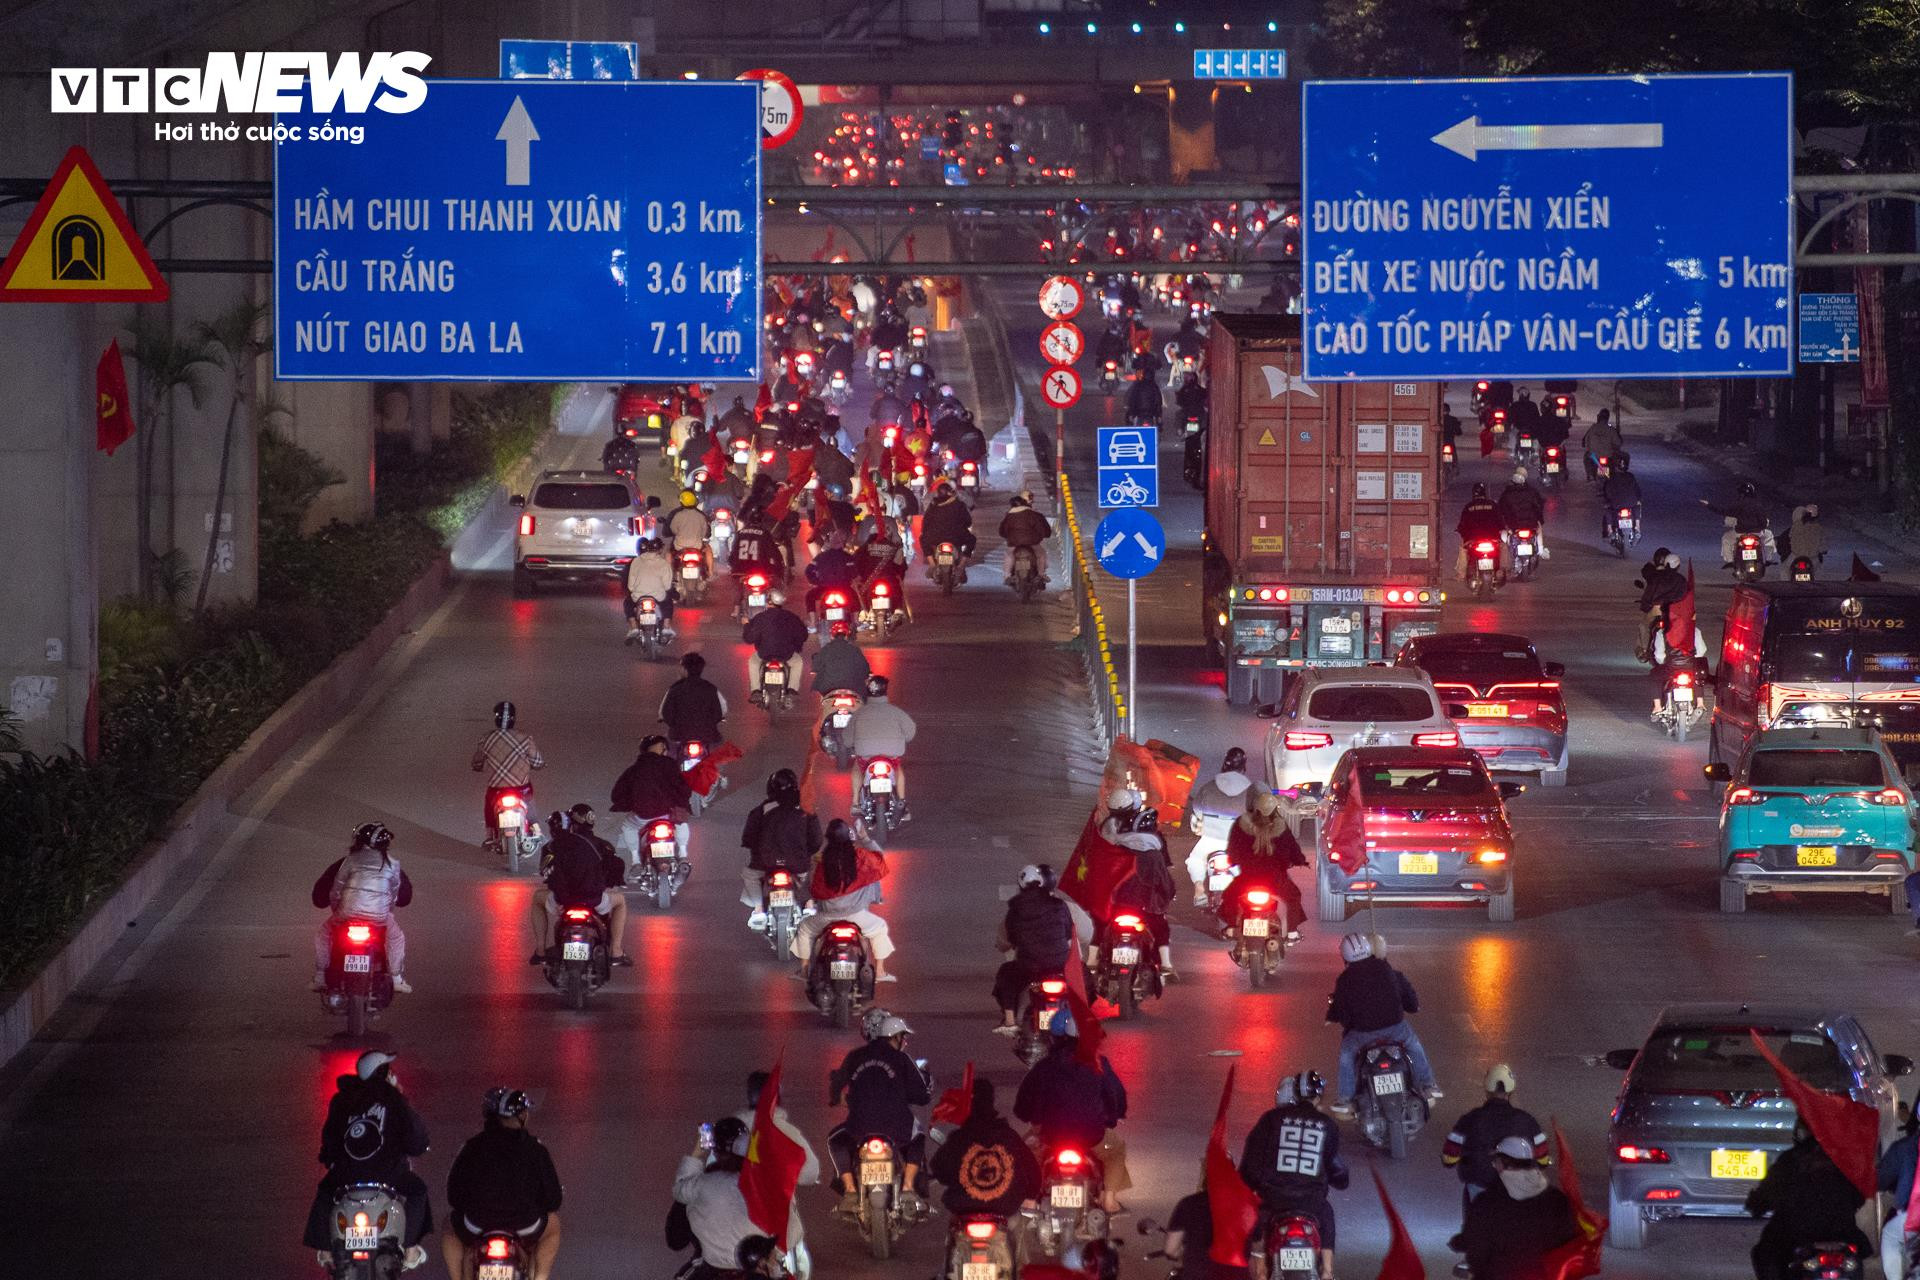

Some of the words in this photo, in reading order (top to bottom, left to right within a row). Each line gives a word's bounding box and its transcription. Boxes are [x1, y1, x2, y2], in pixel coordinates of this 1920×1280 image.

[294, 188, 354, 231] HẦM
[367, 199, 430, 232] CHUI
[443, 199, 533, 232] THANH
[547, 194, 621, 232] XUÂN
[647, 201, 687, 235] 0,3
[699, 201, 743, 233] km
[1312, 190, 1409, 233] ĐƯỜNG
[1422, 186, 1531, 231] NGUYỄN
[1546, 182, 1610, 230] XIỂN
[295, 249, 348, 292] CẦU
[362, 246, 455, 292] TRẮNG
[647, 261, 687, 295] 3,6
[700, 258, 742, 294] km
[1314, 248, 1369, 293] BẾN
[1383, 260, 1417, 293] XE
[1430, 250, 1505, 292] NƯỚC
[1518, 247, 1600, 291] NGẦM
[1719, 256, 1734, 288] 5
[1743, 256, 1788, 288] km
[295, 312, 350, 353] NÚT
[364, 321, 427, 353] GIAO
[440, 321, 476, 353] BA
[489, 321, 524, 353] LA
[650, 321, 687, 356] 7,1
[700, 321, 742, 354] km
[1314, 320, 1367, 354] CAO
[1377, 309, 1431, 353] TỐC
[1440, 310, 1512, 353] PHÁP
[1522, 307, 1649, 352] VÂN-CẦU
[1715, 317, 1730, 350] 6
[1744, 316, 1787, 350] km
[1395, 385, 1416, 395] 45G1
[739, 540, 758, 561] 24
[1807, 619, 1842, 629] ANH
[1847, 619, 1880, 629] HUY
[1884, 619, 1905, 629] 92
[1364, 738, 1379, 746] 30M
[1808, 849, 1825, 857] 29E
[1727, 1154, 1748, 1164] 29E
